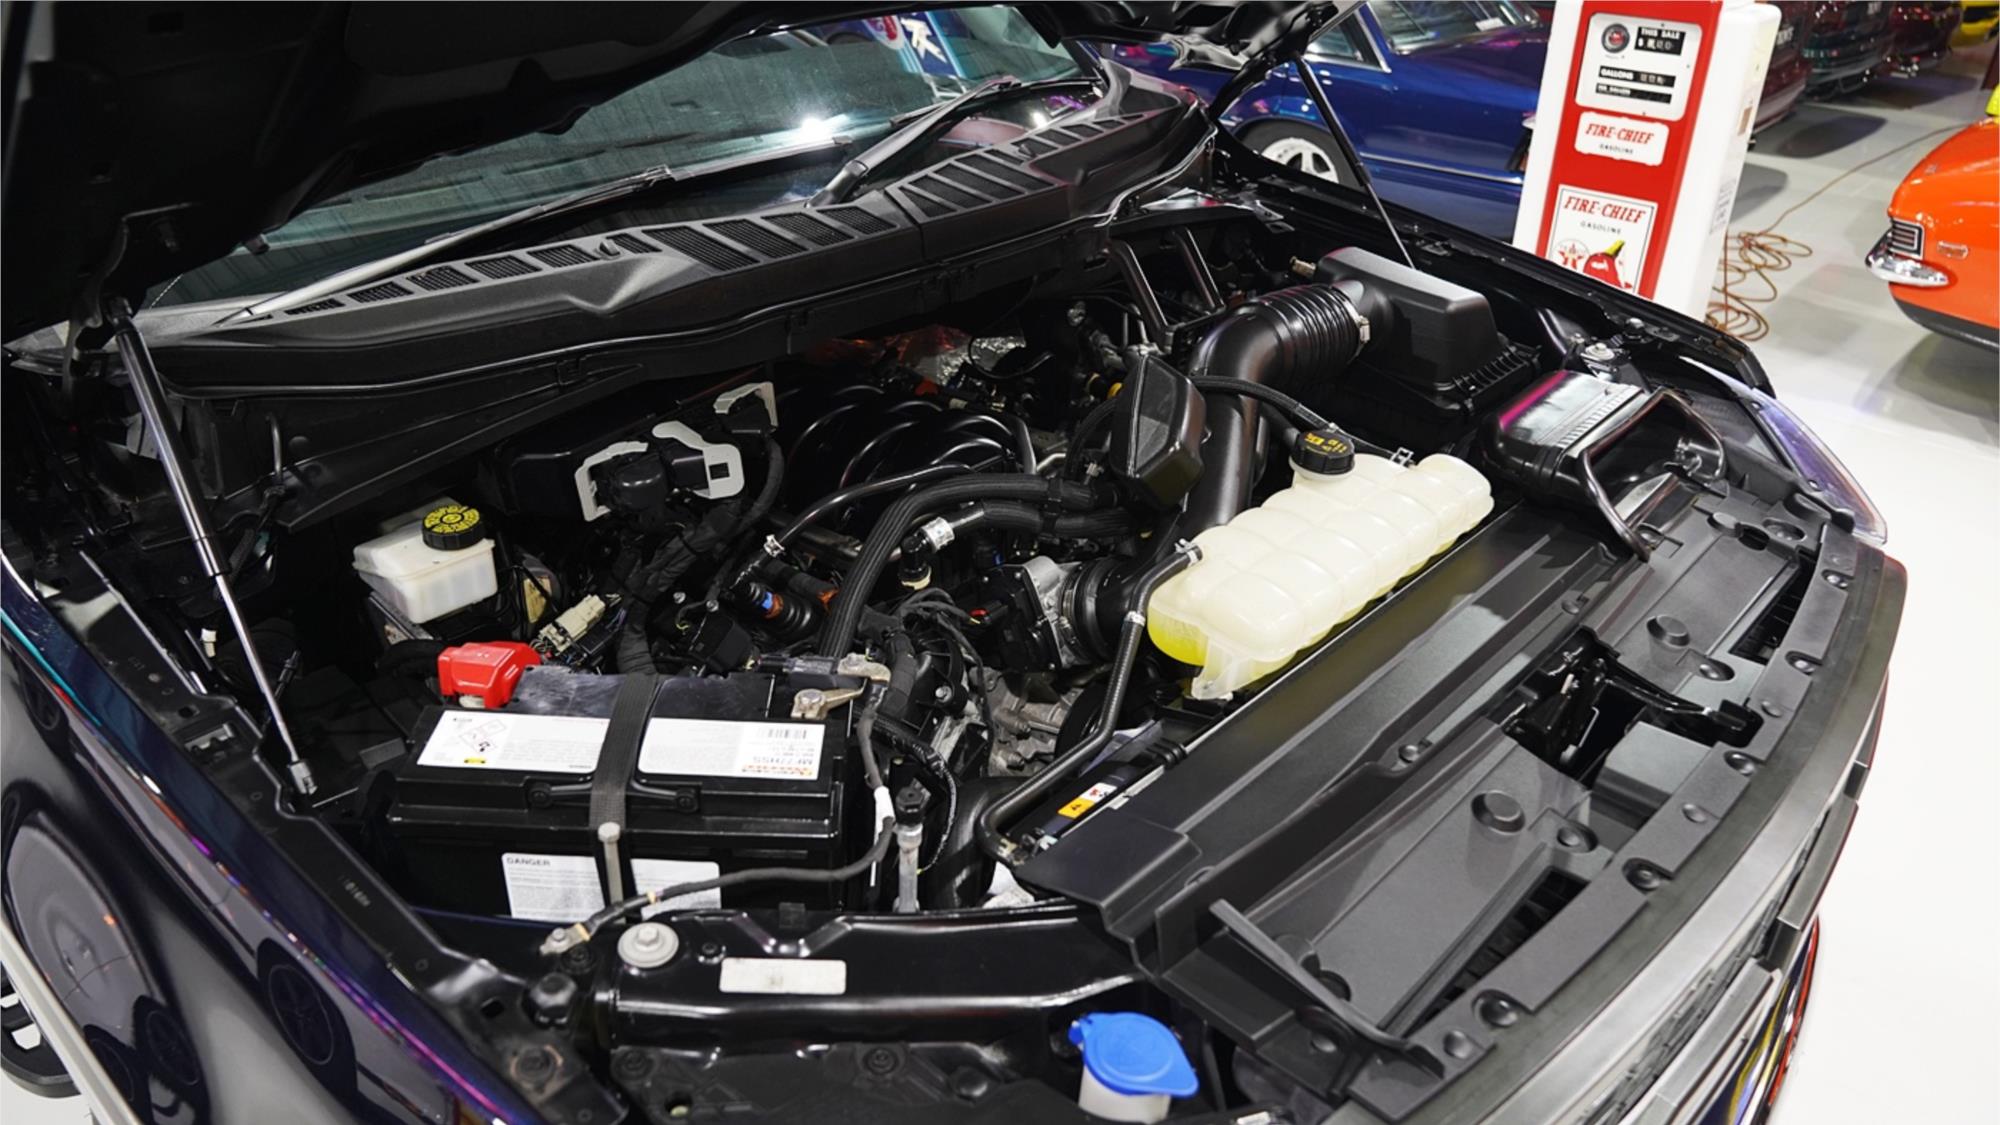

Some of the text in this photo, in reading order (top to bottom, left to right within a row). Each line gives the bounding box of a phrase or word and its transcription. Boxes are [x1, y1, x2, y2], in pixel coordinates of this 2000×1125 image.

[1600, 69, 1634, 81] GALLONS
[1580, 220, 1622, 235] GASOLINE
[506, 857, 551, 866] DANGER
